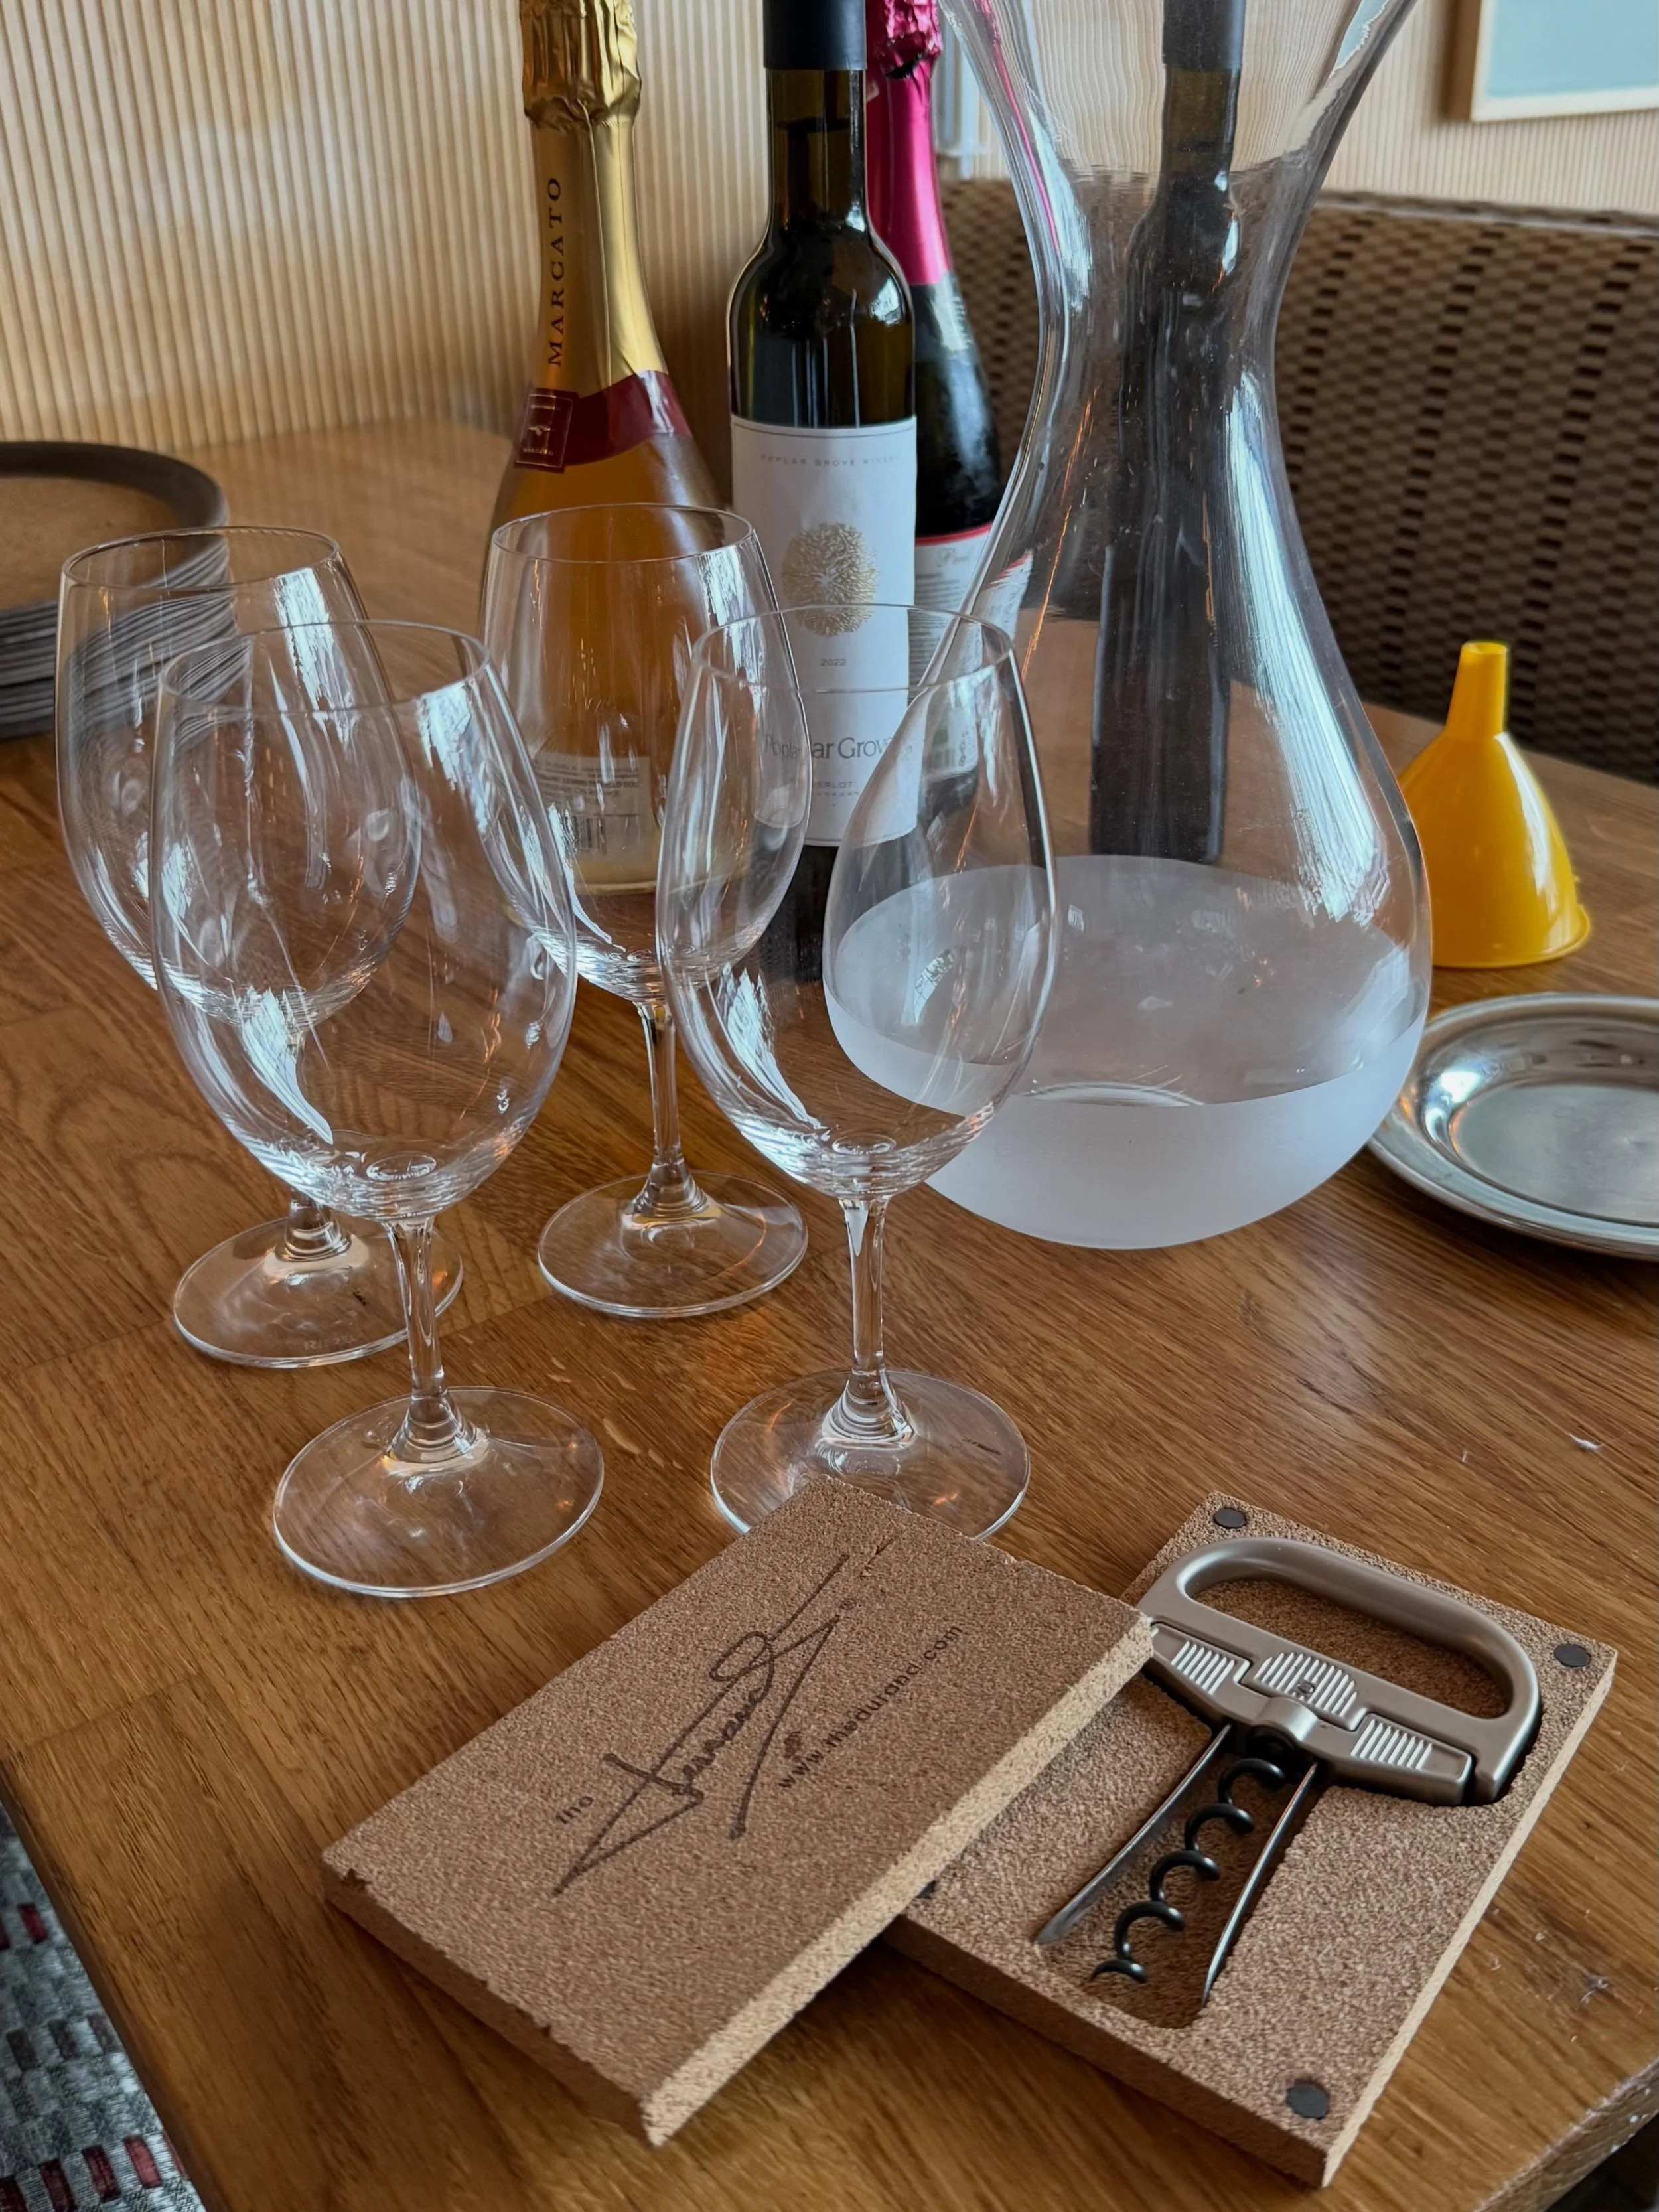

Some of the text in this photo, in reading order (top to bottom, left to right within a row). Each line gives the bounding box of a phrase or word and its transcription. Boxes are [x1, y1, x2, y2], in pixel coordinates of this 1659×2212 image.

[547, 177, 565, 367] MARCATO
[820, 658, 847, 667] 2022
[815, 781, 853, 790] ERLOT
[778, 1626, 963, 1790] www.thedurand.com
